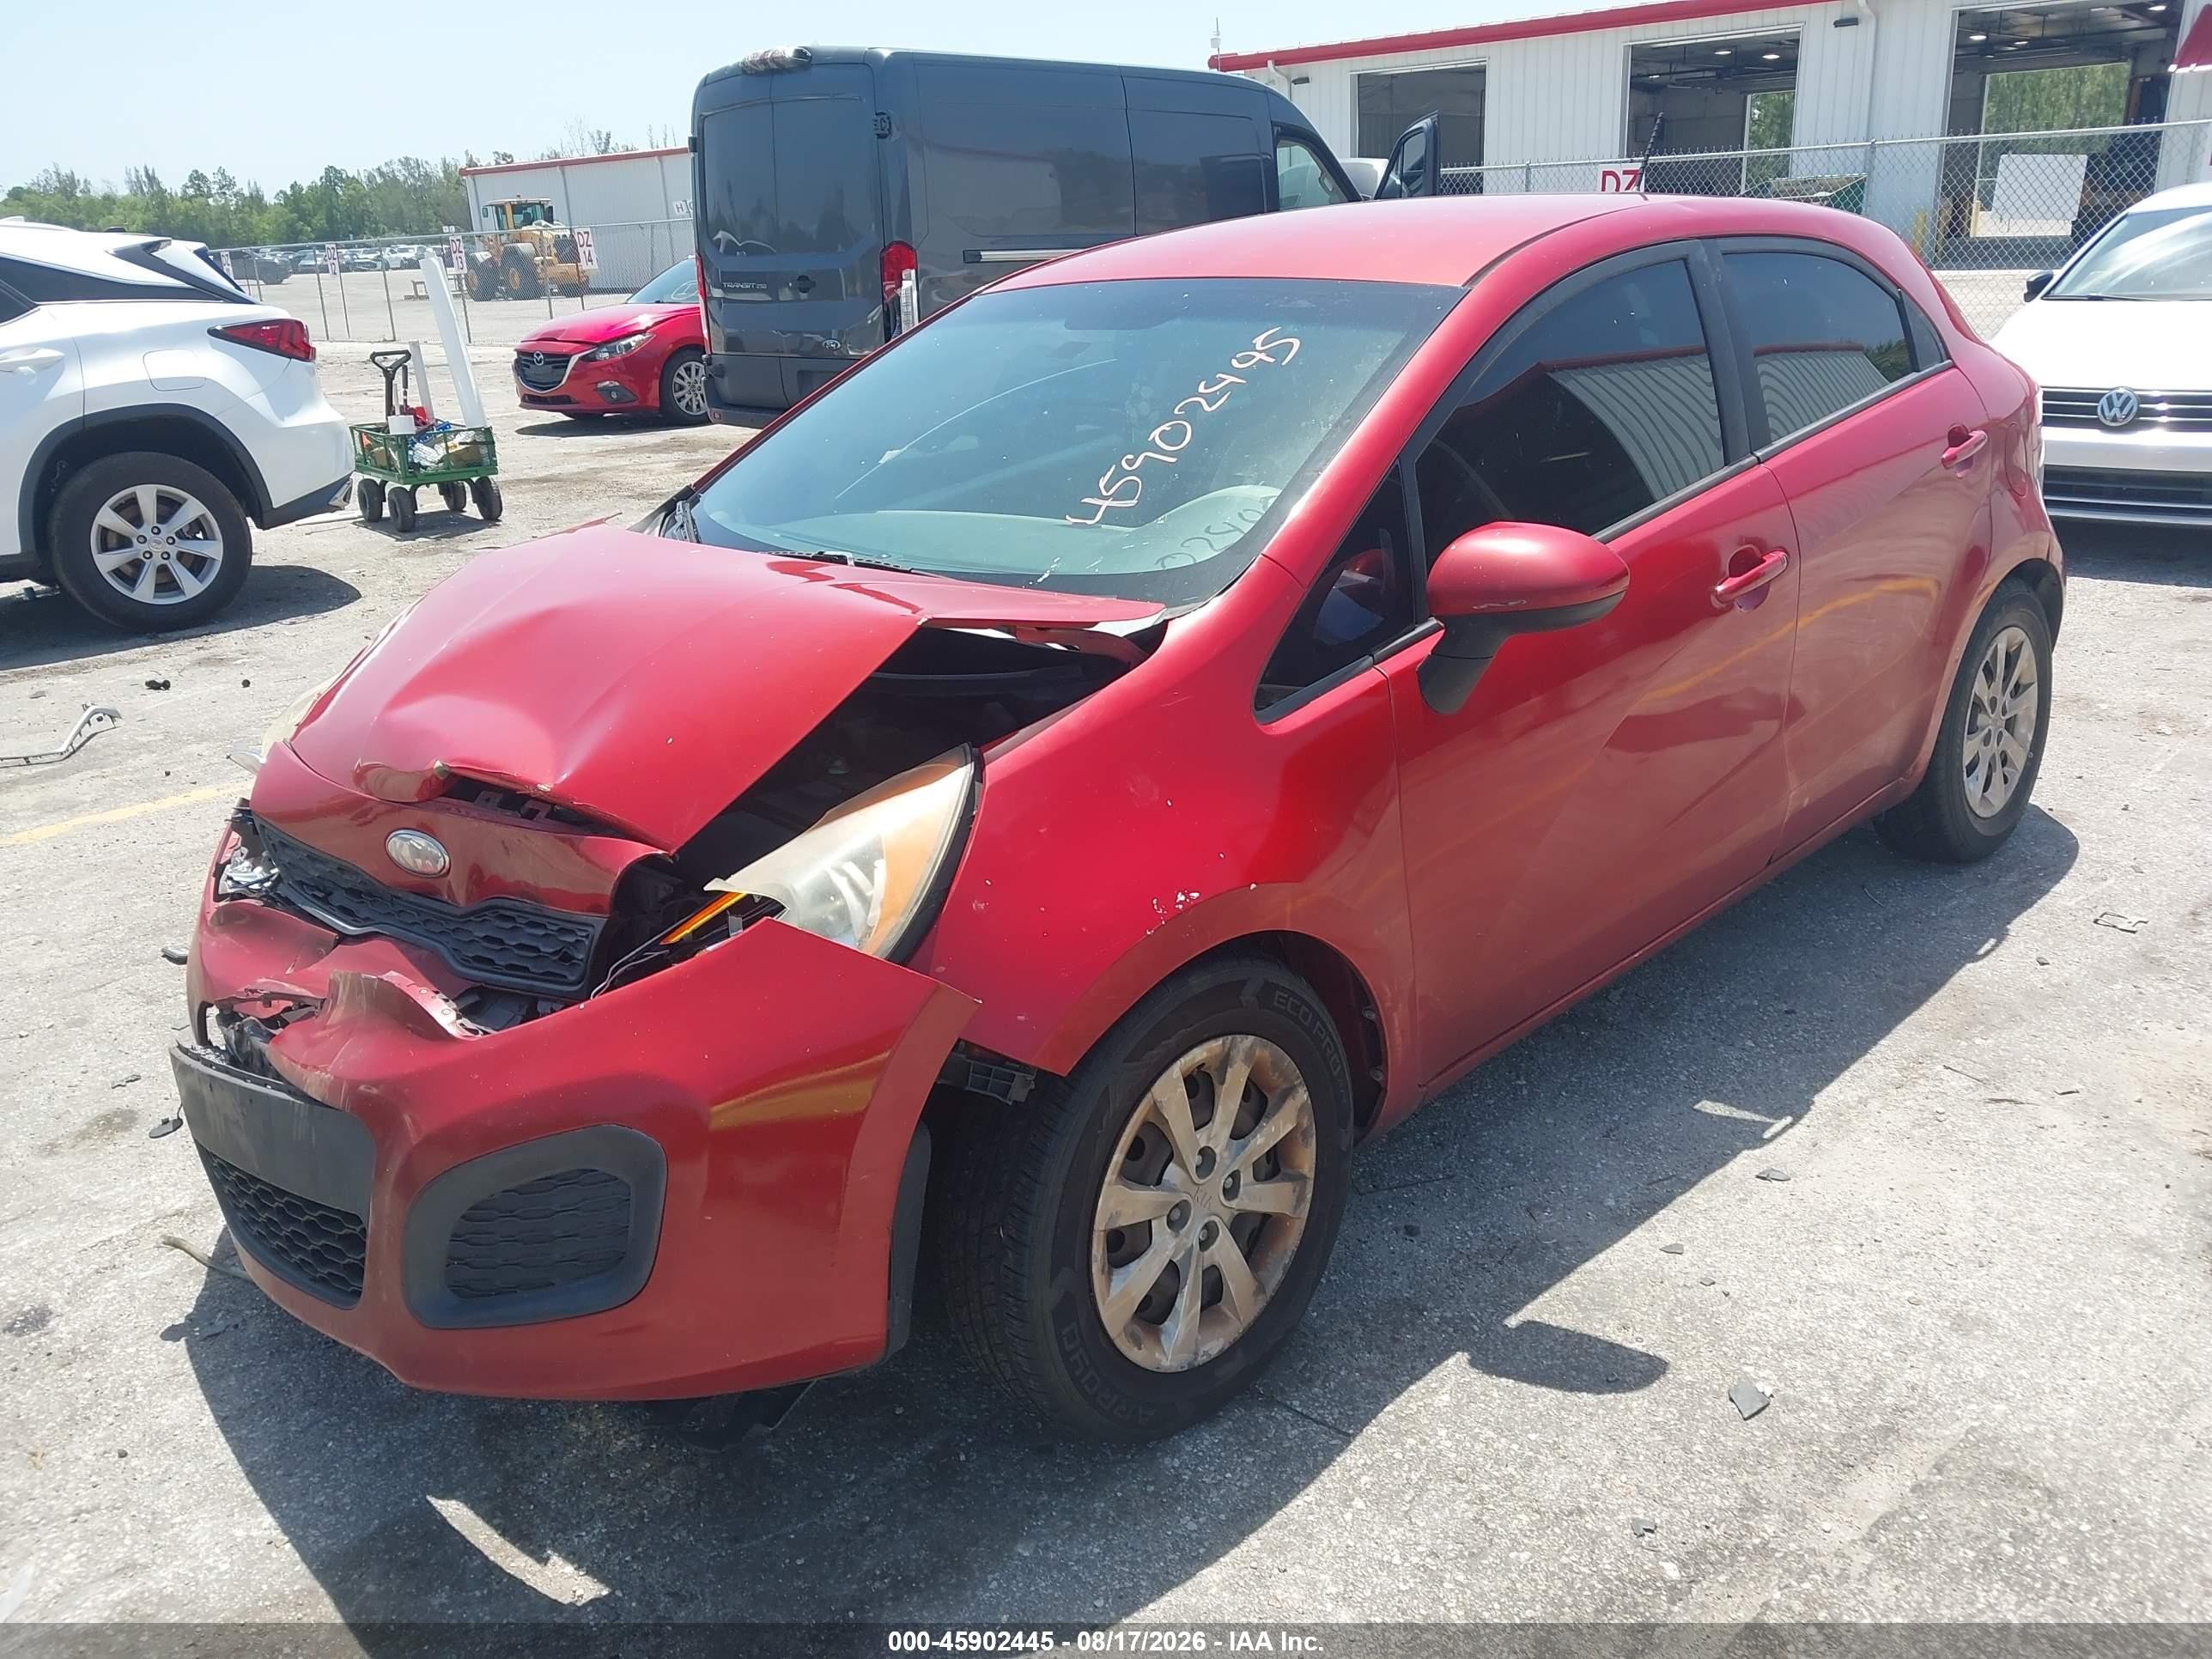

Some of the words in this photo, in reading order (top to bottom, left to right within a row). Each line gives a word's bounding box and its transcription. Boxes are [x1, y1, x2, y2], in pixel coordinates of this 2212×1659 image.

[450, 239, 463, 254] DZ
[576, 231, 592, 248] DZ
[327, 246, 337, 261] DZ
[582, 249, 593, 265] 14
[330, 262, 337, 276] 12
[455, 255, 465, 270] 13
[1273, 989, 1313, 1026] ECO
